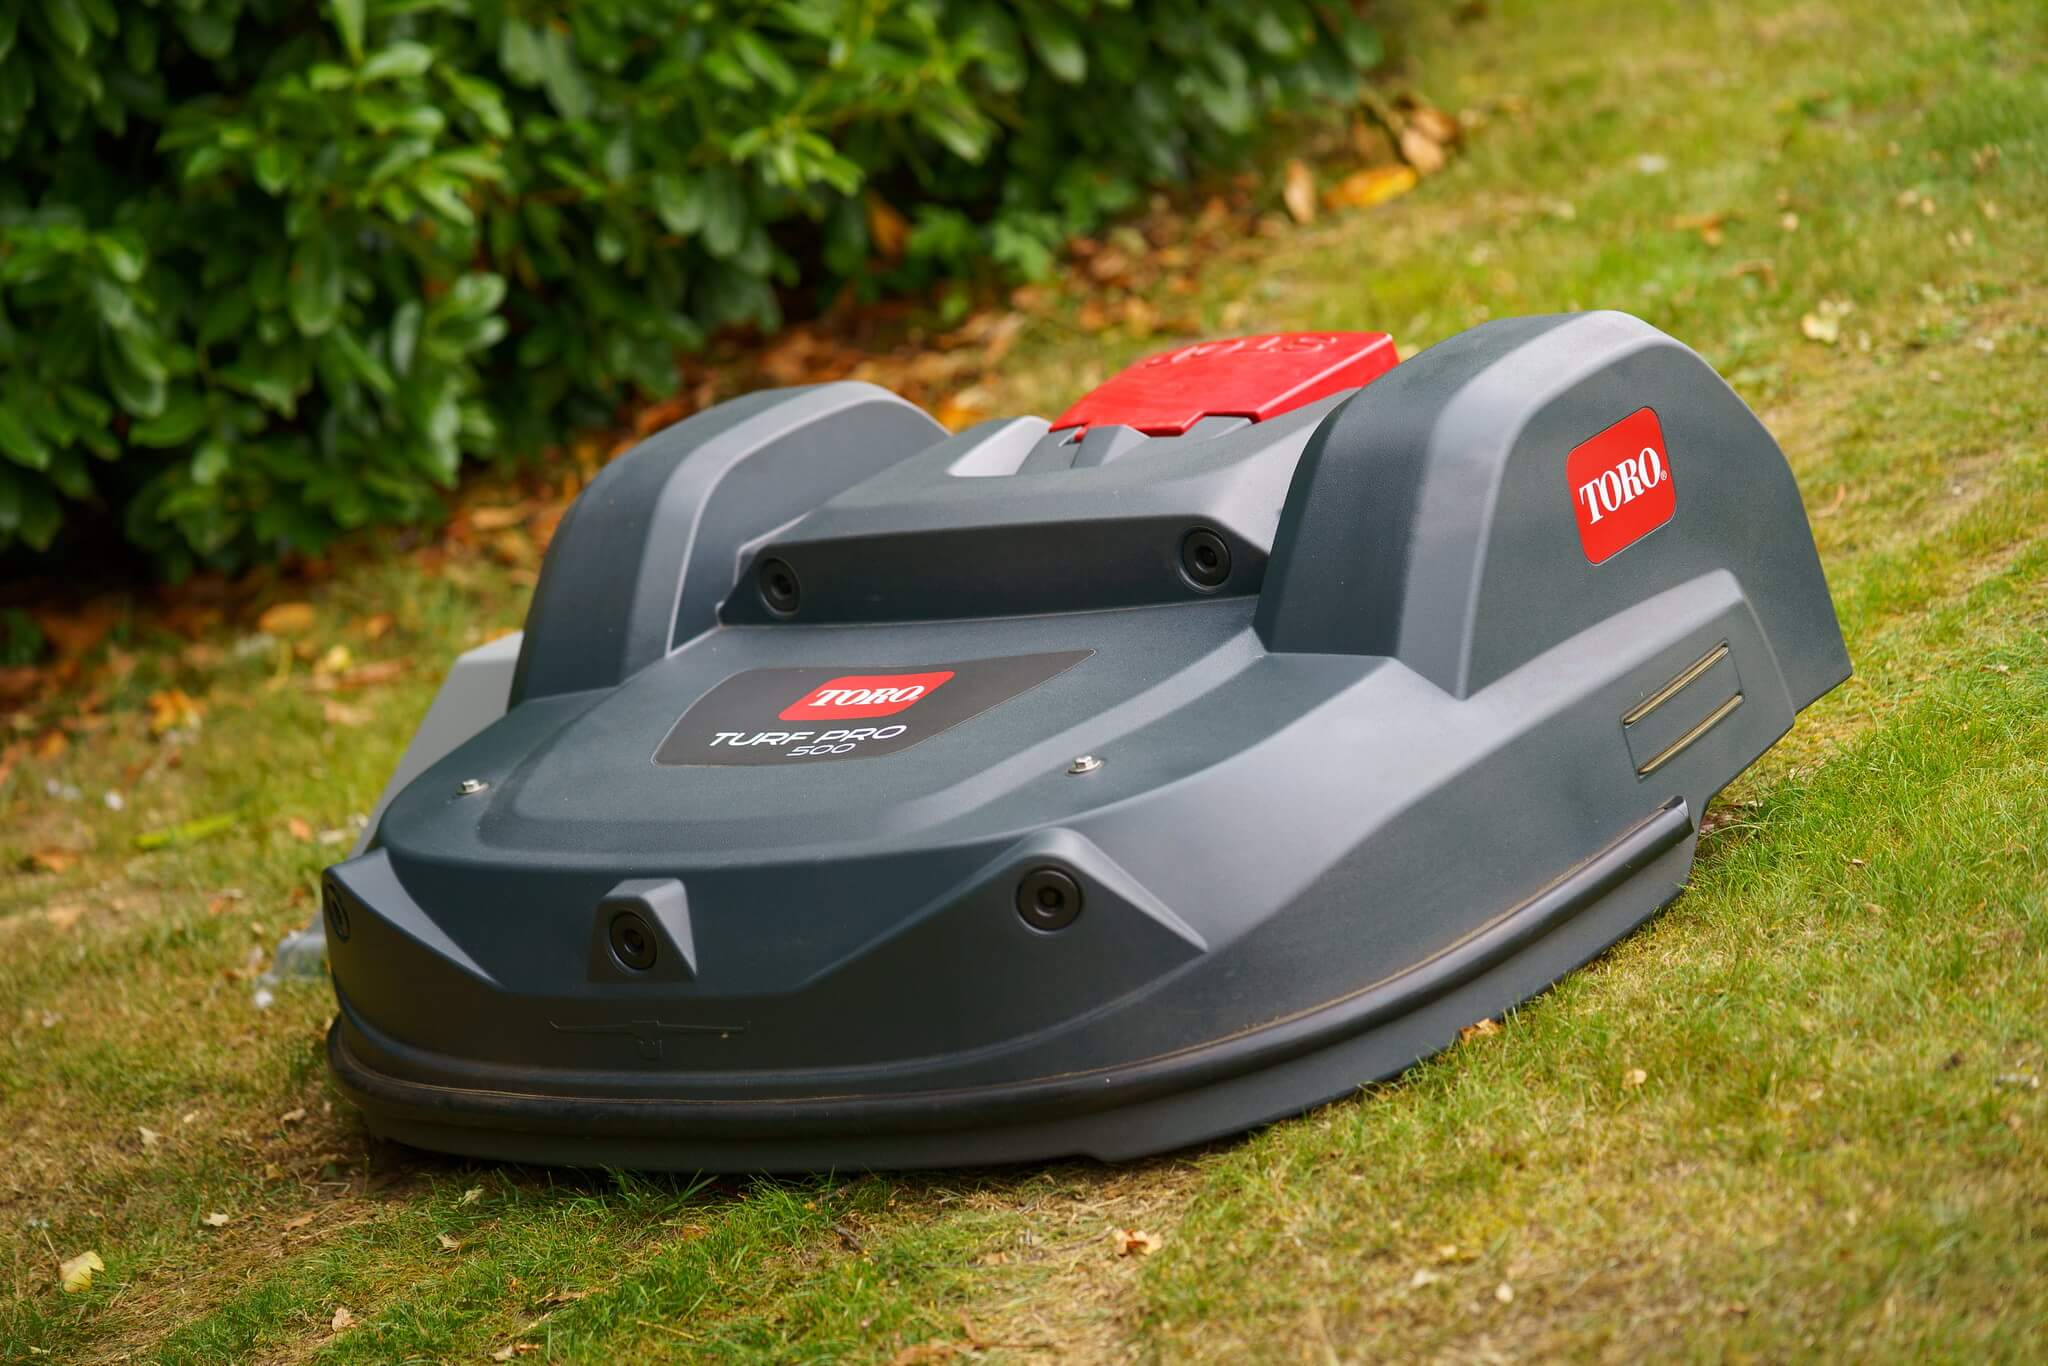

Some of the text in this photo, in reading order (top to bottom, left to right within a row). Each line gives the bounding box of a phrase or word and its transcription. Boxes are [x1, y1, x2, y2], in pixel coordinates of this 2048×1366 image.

[709, 725, 907, 747] TURF PRO
[786, 743, 857, 757] 500
